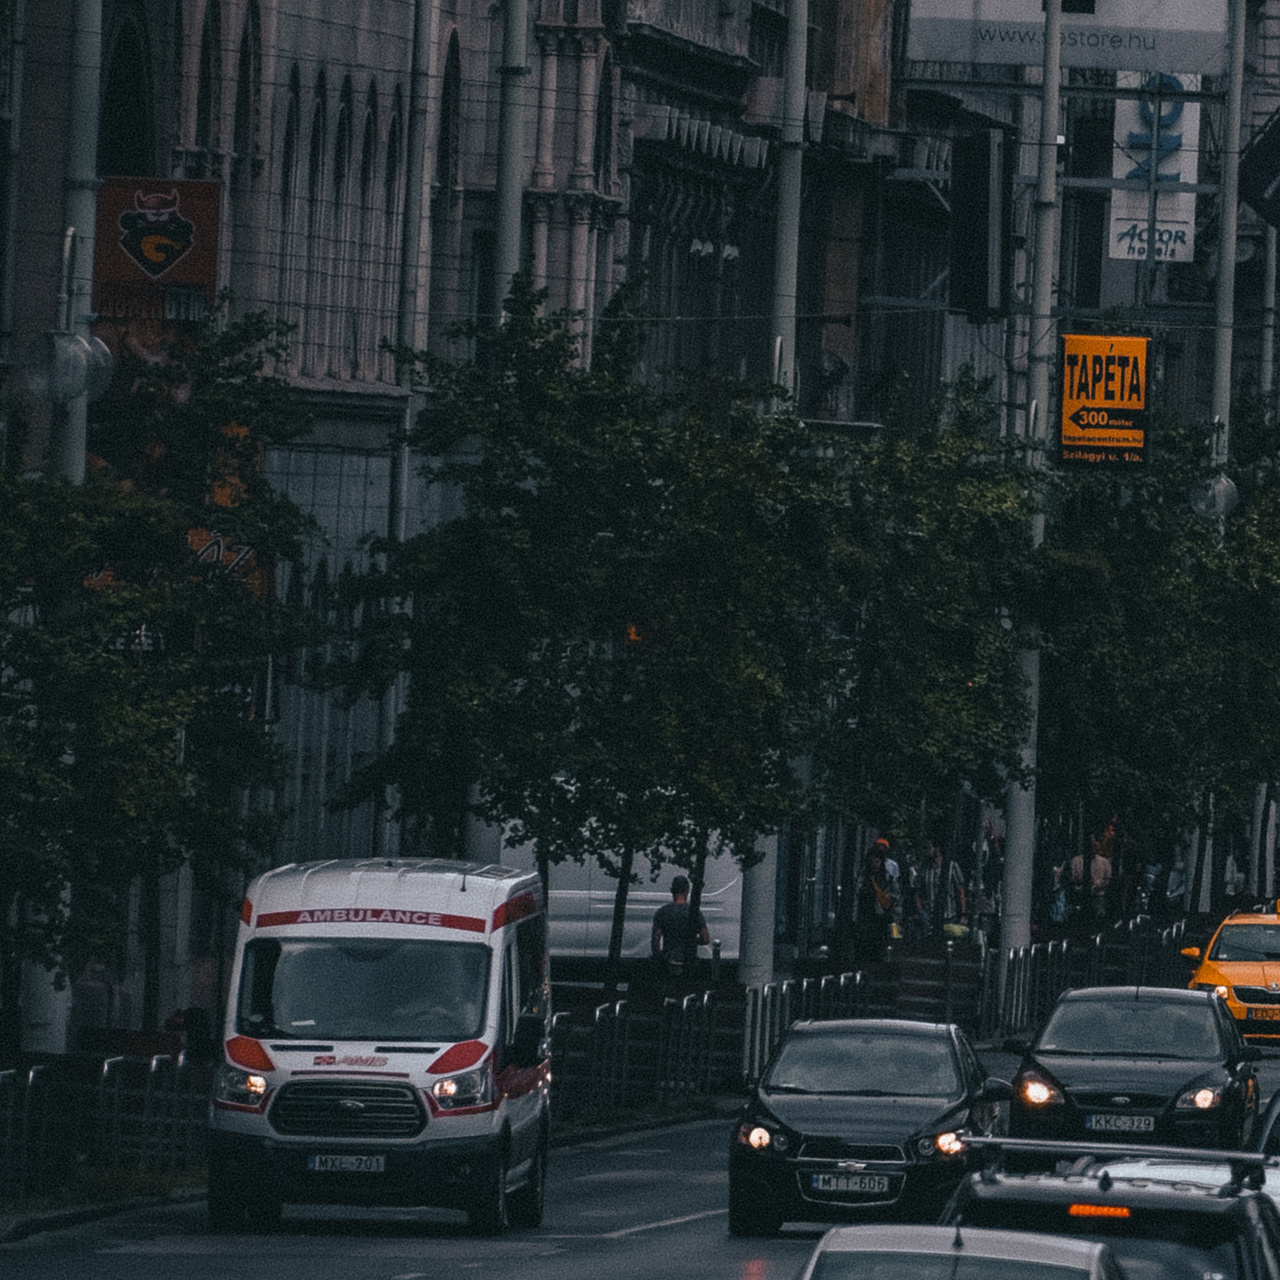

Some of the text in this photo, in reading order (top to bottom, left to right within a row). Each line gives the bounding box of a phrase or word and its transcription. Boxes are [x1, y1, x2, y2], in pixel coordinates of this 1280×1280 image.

[1066, 343, 1142, 402] TAPÉTA
[1078, 410, 1109, 426] 300
[296, 910, 442, 926] AMBULANCE
[821, 1174, 886, 1191] MTT-606
